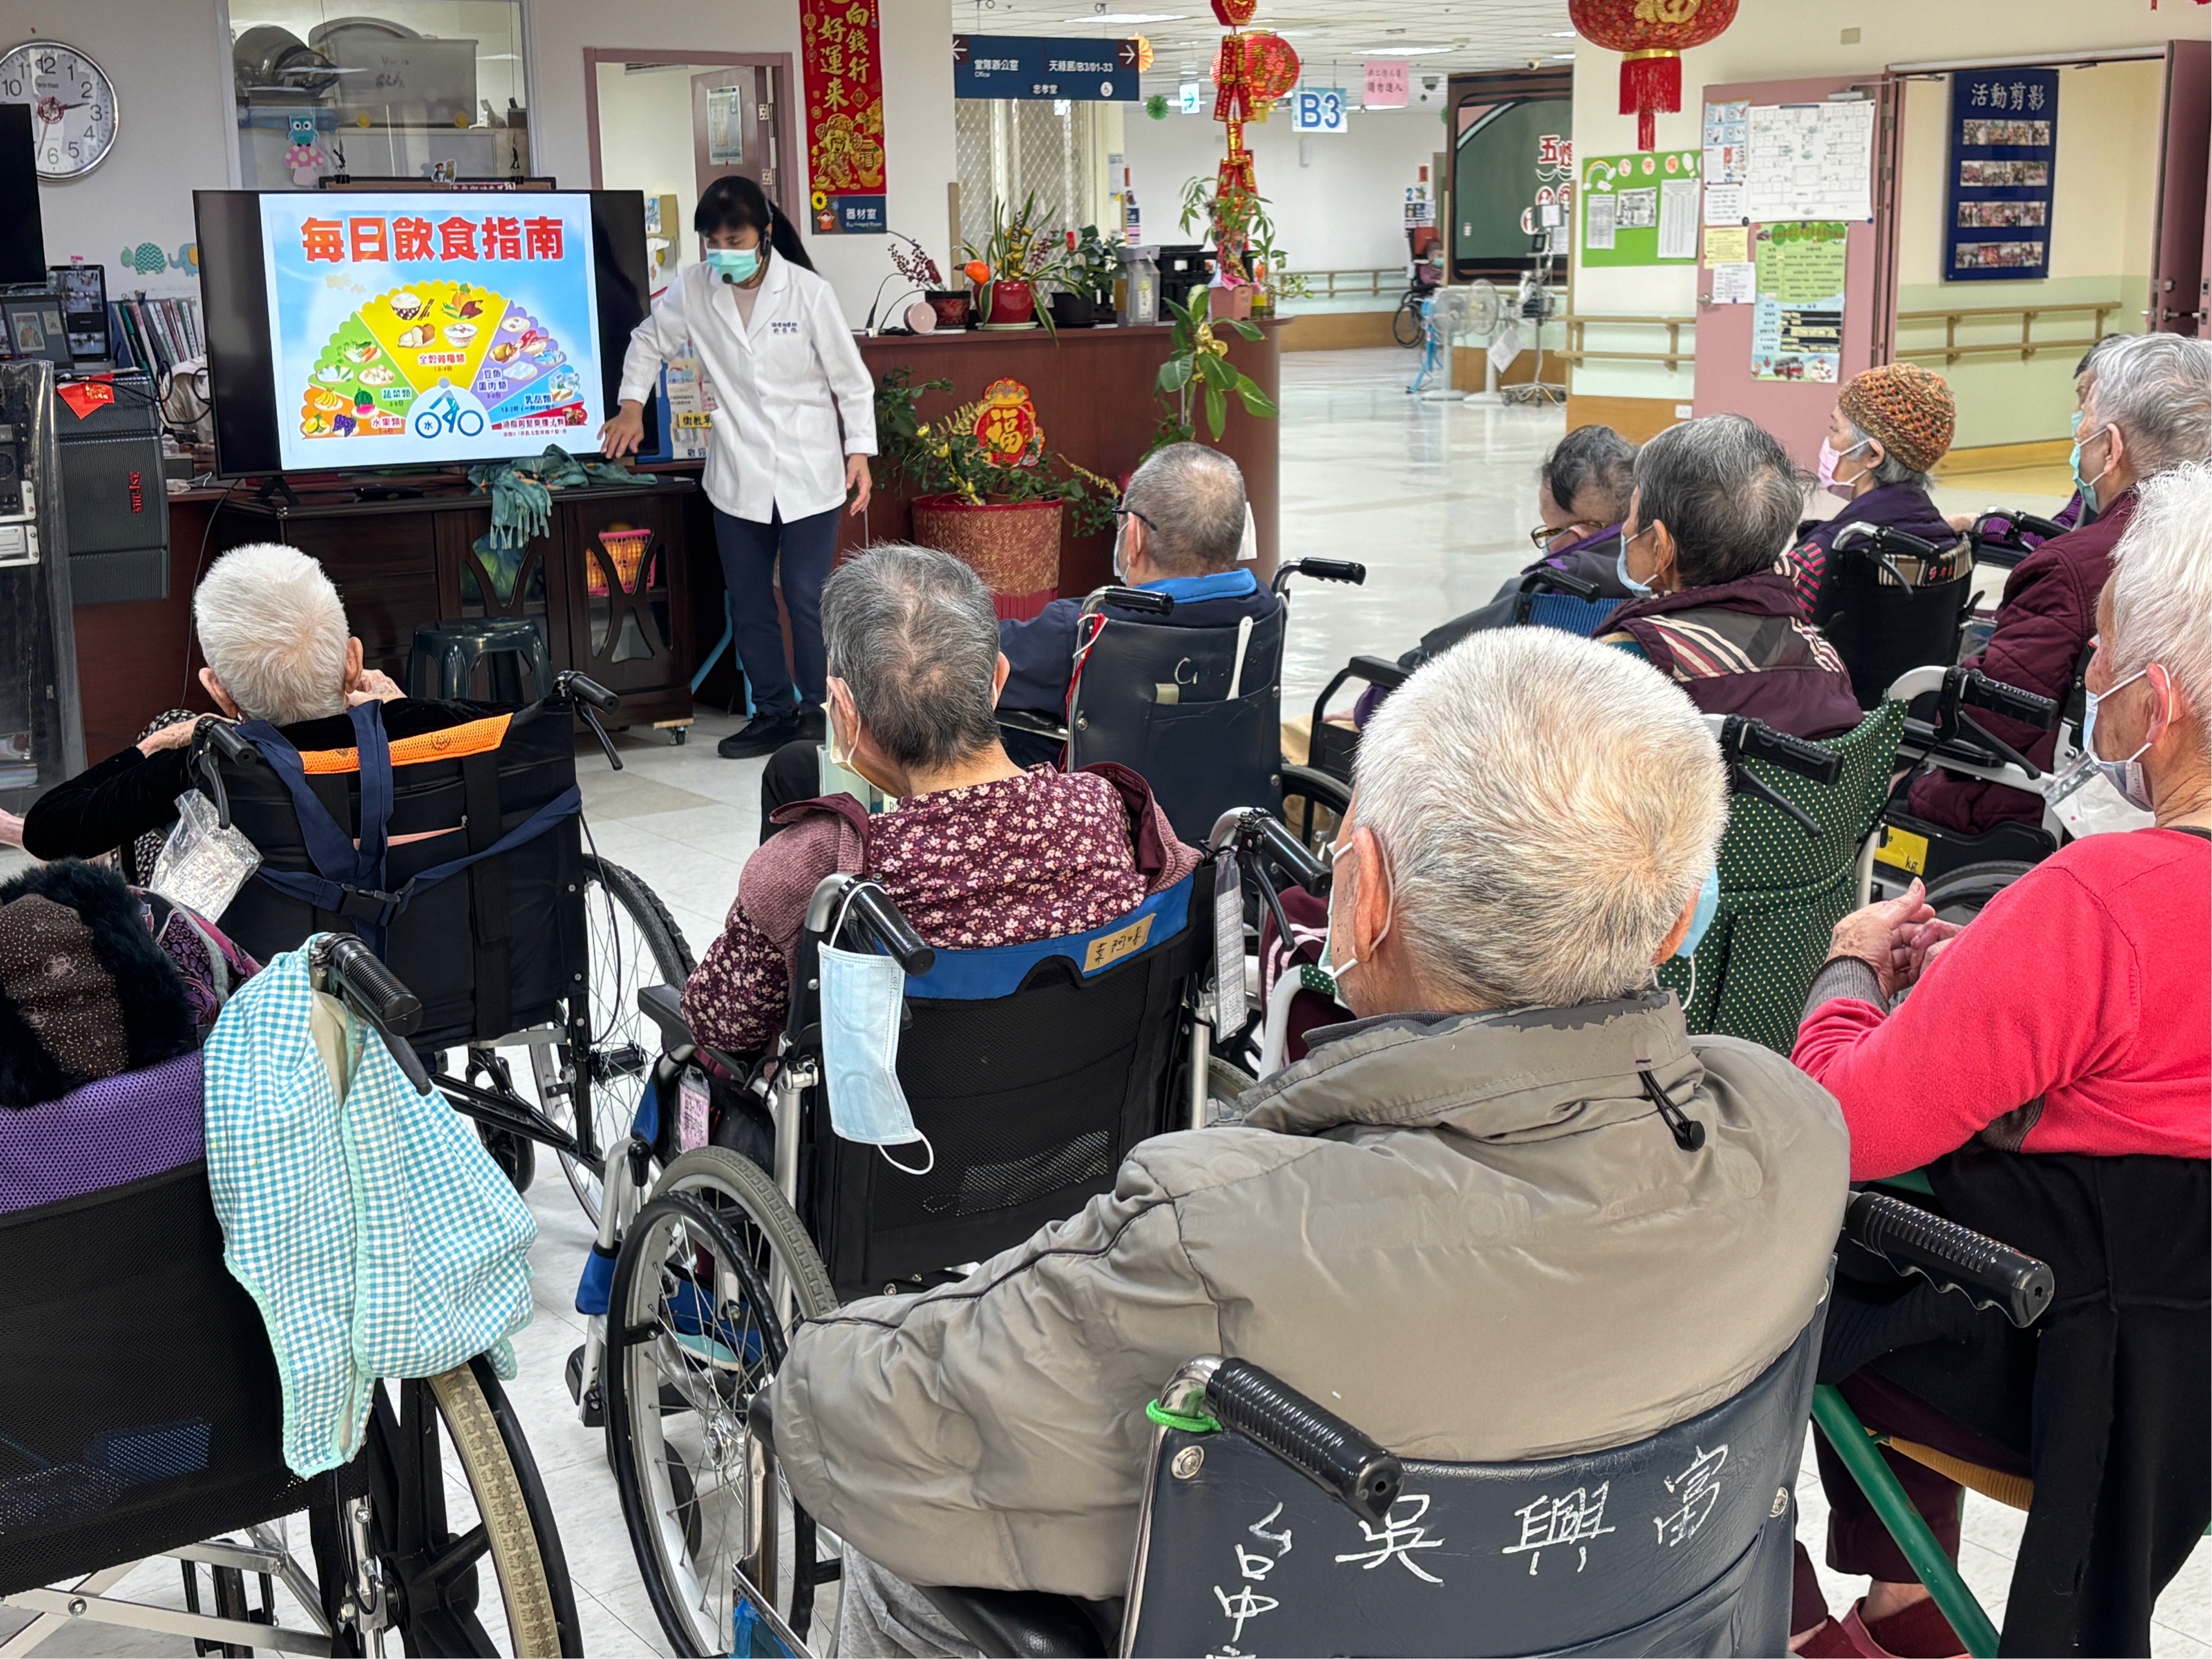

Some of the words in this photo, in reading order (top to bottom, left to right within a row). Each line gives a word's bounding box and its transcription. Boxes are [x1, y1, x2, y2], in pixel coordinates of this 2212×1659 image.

[846, 2, 871, 83] 向錢行
[40, 56, 56, 75] 12
[67, 64, 74, 81] 1
[2, 79, 22, 96] 10
[81, 81, 93, 99] 2
[1971, 82, 2045, 111] 活動剪影
[90, 104, 103, 121] 3
[1301, 93, 1340, 128] B3
[83, 125, 96, 141] 4
[47, 147, 59, 164] 6
[68, 141, 80, 159] 5
[300, 216, 565, 263] 每日飲食指南
[423, 421, 433, 431] 水
[985, 408, 1024, 454] 福
